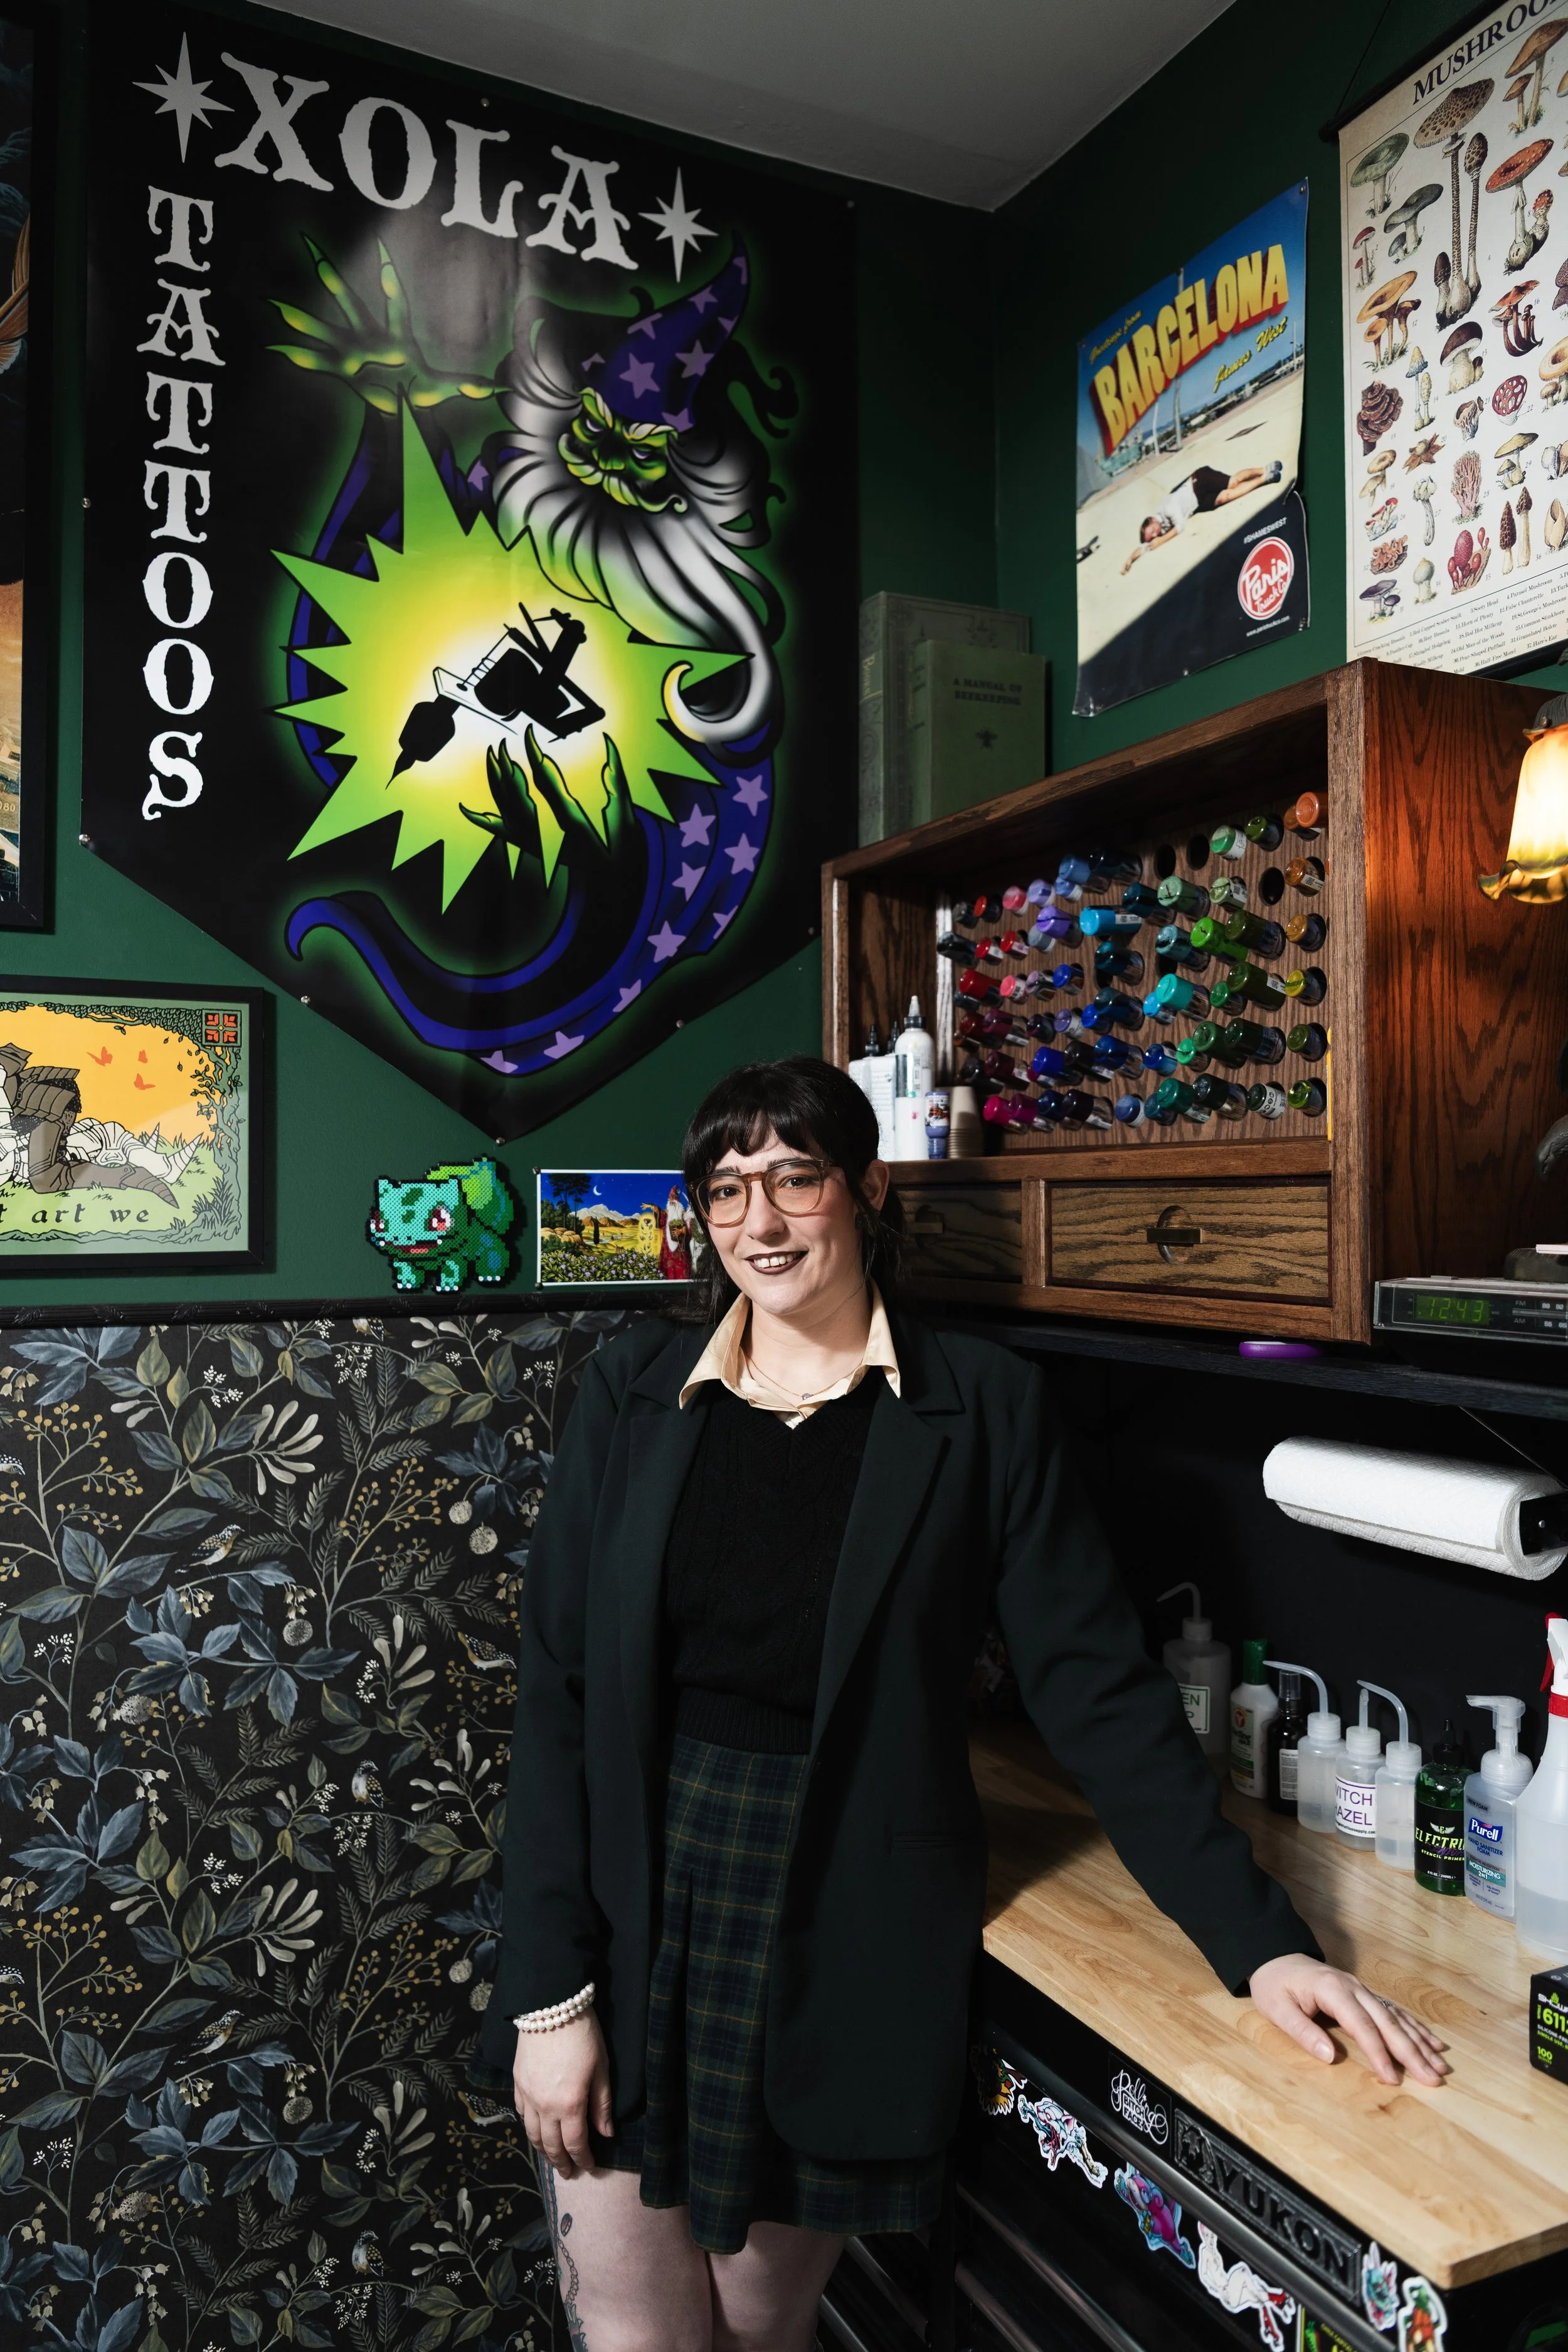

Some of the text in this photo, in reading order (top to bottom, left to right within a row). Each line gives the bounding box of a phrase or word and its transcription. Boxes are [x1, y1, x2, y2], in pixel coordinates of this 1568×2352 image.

[1412, 0, 1557, 105] MUSHROO
[215, 51, 638, 270] XOLA
[1090, 243, 1290, 450] BARCELONA
[137, 184, 226, 820] TATTOOS
[1242, 558, 1289, 612] Paris
[1487, 599, 1498, 607] Head
[1528, 578, 1553, 591] Mushroom
[1255, 586, 1279, 613] Truck
[1518, 593, 1544, 607] Chanterelle
[1484, 621, 1502, 630] Milkcap
[1542, 596, 1567, 609] Mushroom
[1490, 631, 1505, 640] Woods
[1541, 610, 1565, 622] Stinkhorn
[1503, 649, 1517, 657] Morel
[31, 1204, 150, 1223] art we
[1476, 1802, 1488, 1812] FOAM
[1471, 1818, 1499, 1841] Purell
[1421, 1849, 1442, 1859] STENCIL
[1468, 1836, 1503, 1856] HAND SANITIZER
[1476, 1846, 1490, 1857] FOAM
[1470, 1860, 1501, 1880] MOISTURIZING
[1537, 2046, 1552, 2060] 100
[1123, 2095, 1145, 2119] BITCH
[1123, 2107, 1143, 2131] FACE
[1217, 2155, 1352, 2289] YUKON
